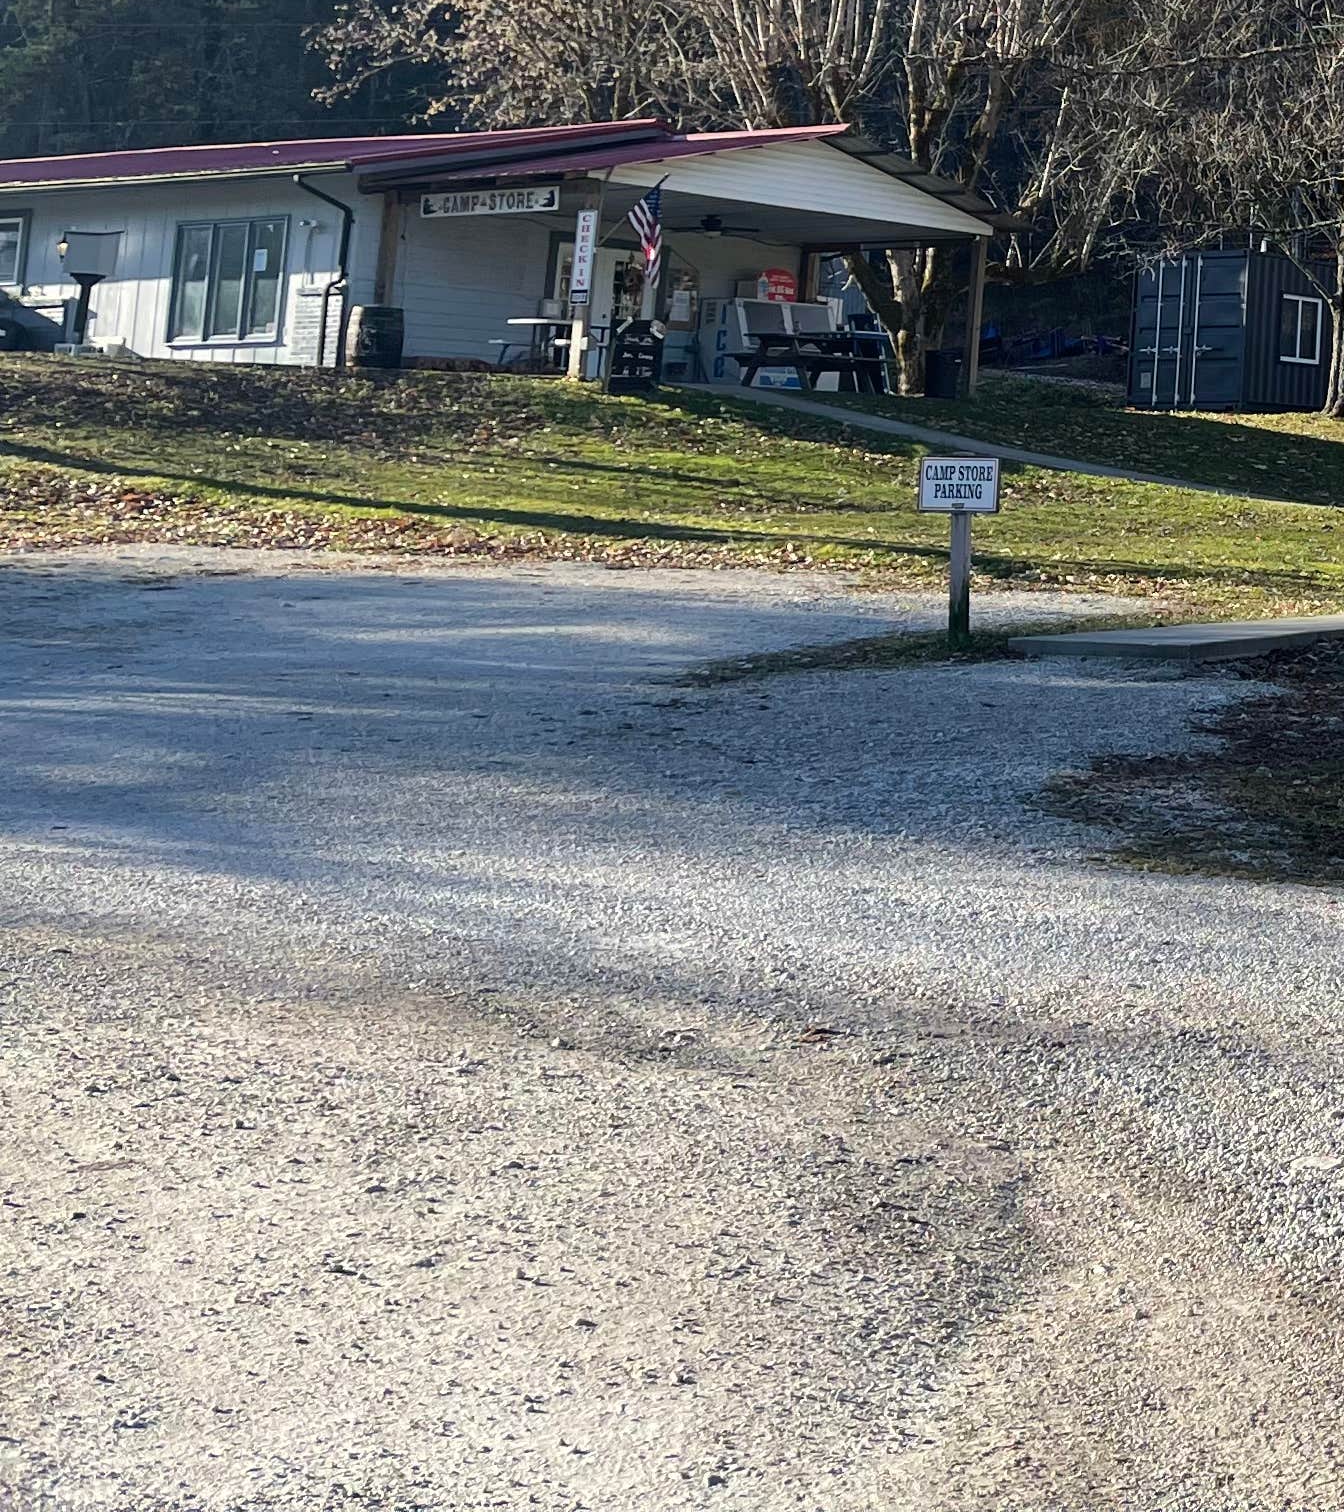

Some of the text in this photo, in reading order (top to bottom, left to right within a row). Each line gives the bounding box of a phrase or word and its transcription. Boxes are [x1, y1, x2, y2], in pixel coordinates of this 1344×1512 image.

[443, 191, 535, 214] CAMP STORE
[578, 214, 592, 264] CHECK
[576, 268, 585, 287] IN
[925, 464, 994, 482] CAMP STORE
[934, 483, 983, 500] PARKING
